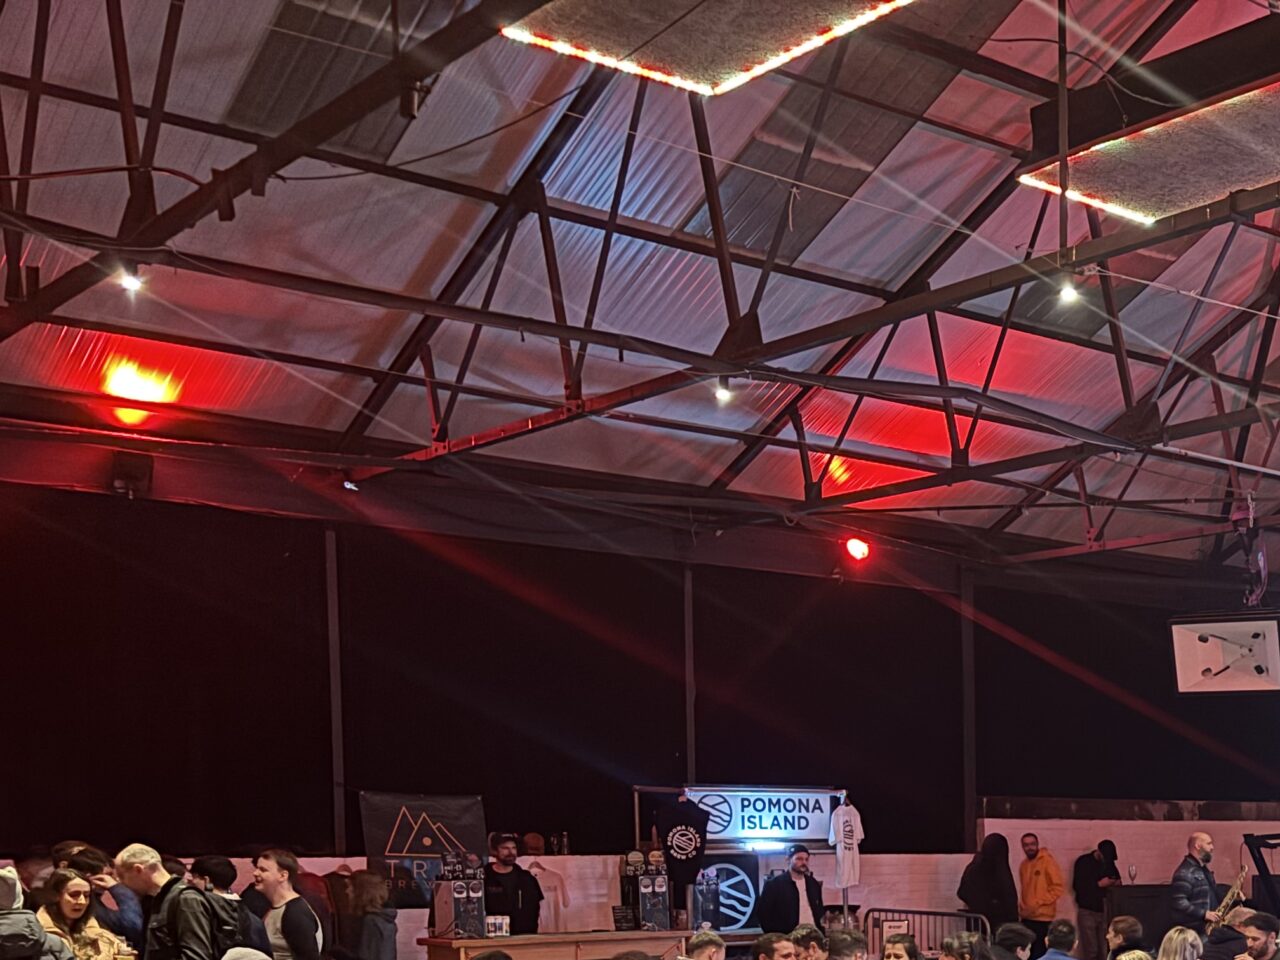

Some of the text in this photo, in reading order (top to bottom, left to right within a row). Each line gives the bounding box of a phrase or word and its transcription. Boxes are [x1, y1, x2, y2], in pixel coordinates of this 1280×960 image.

[741, 797, 824, 814] POMONA
[741, 815, 810, 831] ISLAND
[667, 825, 686, 846] POMONA
[670, 849, 697, 860] BREW CO
